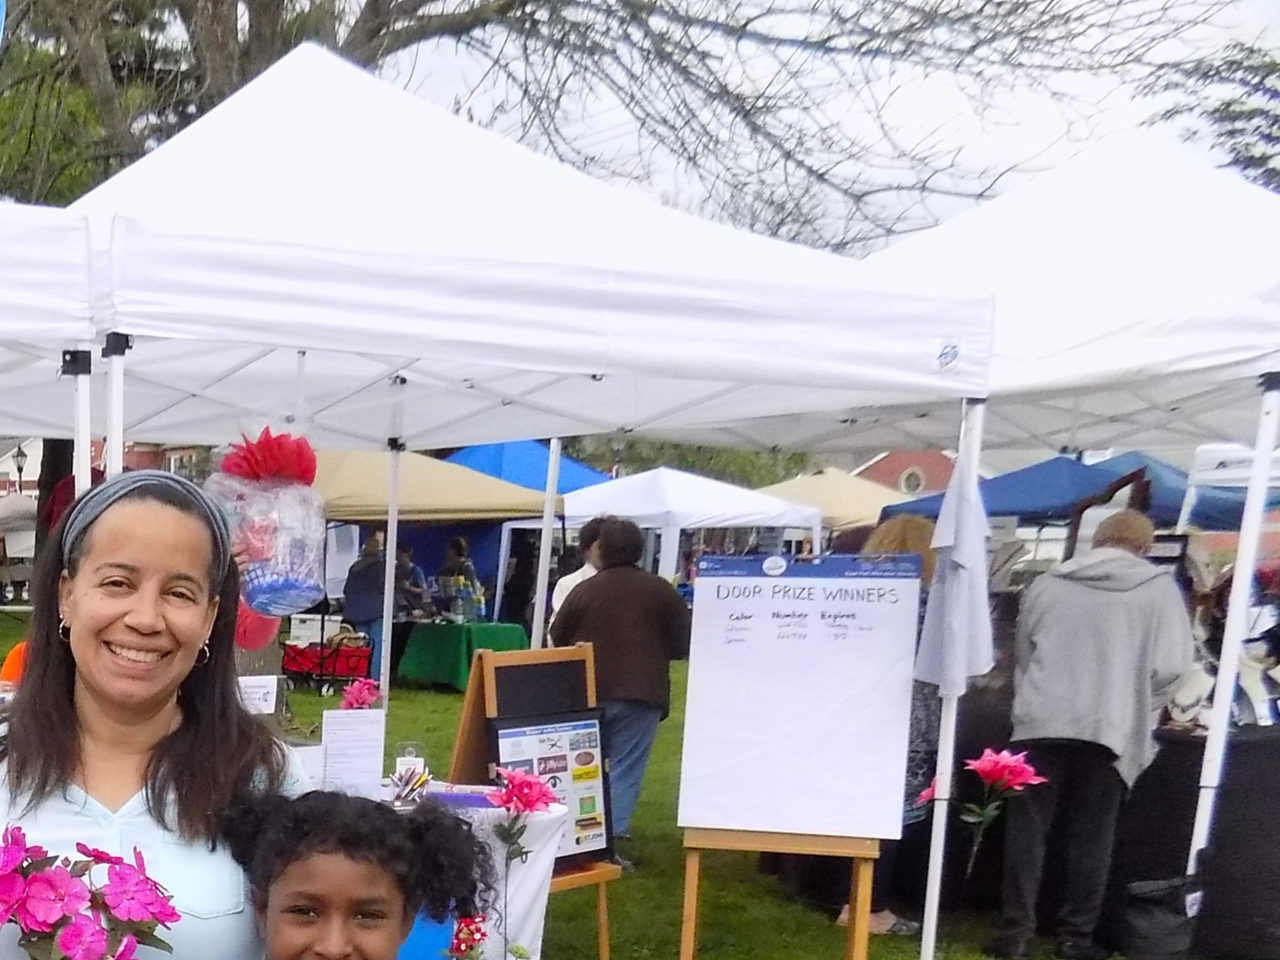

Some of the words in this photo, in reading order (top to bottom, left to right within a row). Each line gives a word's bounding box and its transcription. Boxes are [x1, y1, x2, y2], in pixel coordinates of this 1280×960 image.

[716, 585, 763, 600] DOOR
[771, 585, 815, 601] PRIZE
[823, 587, 899, 604] WINNERS
